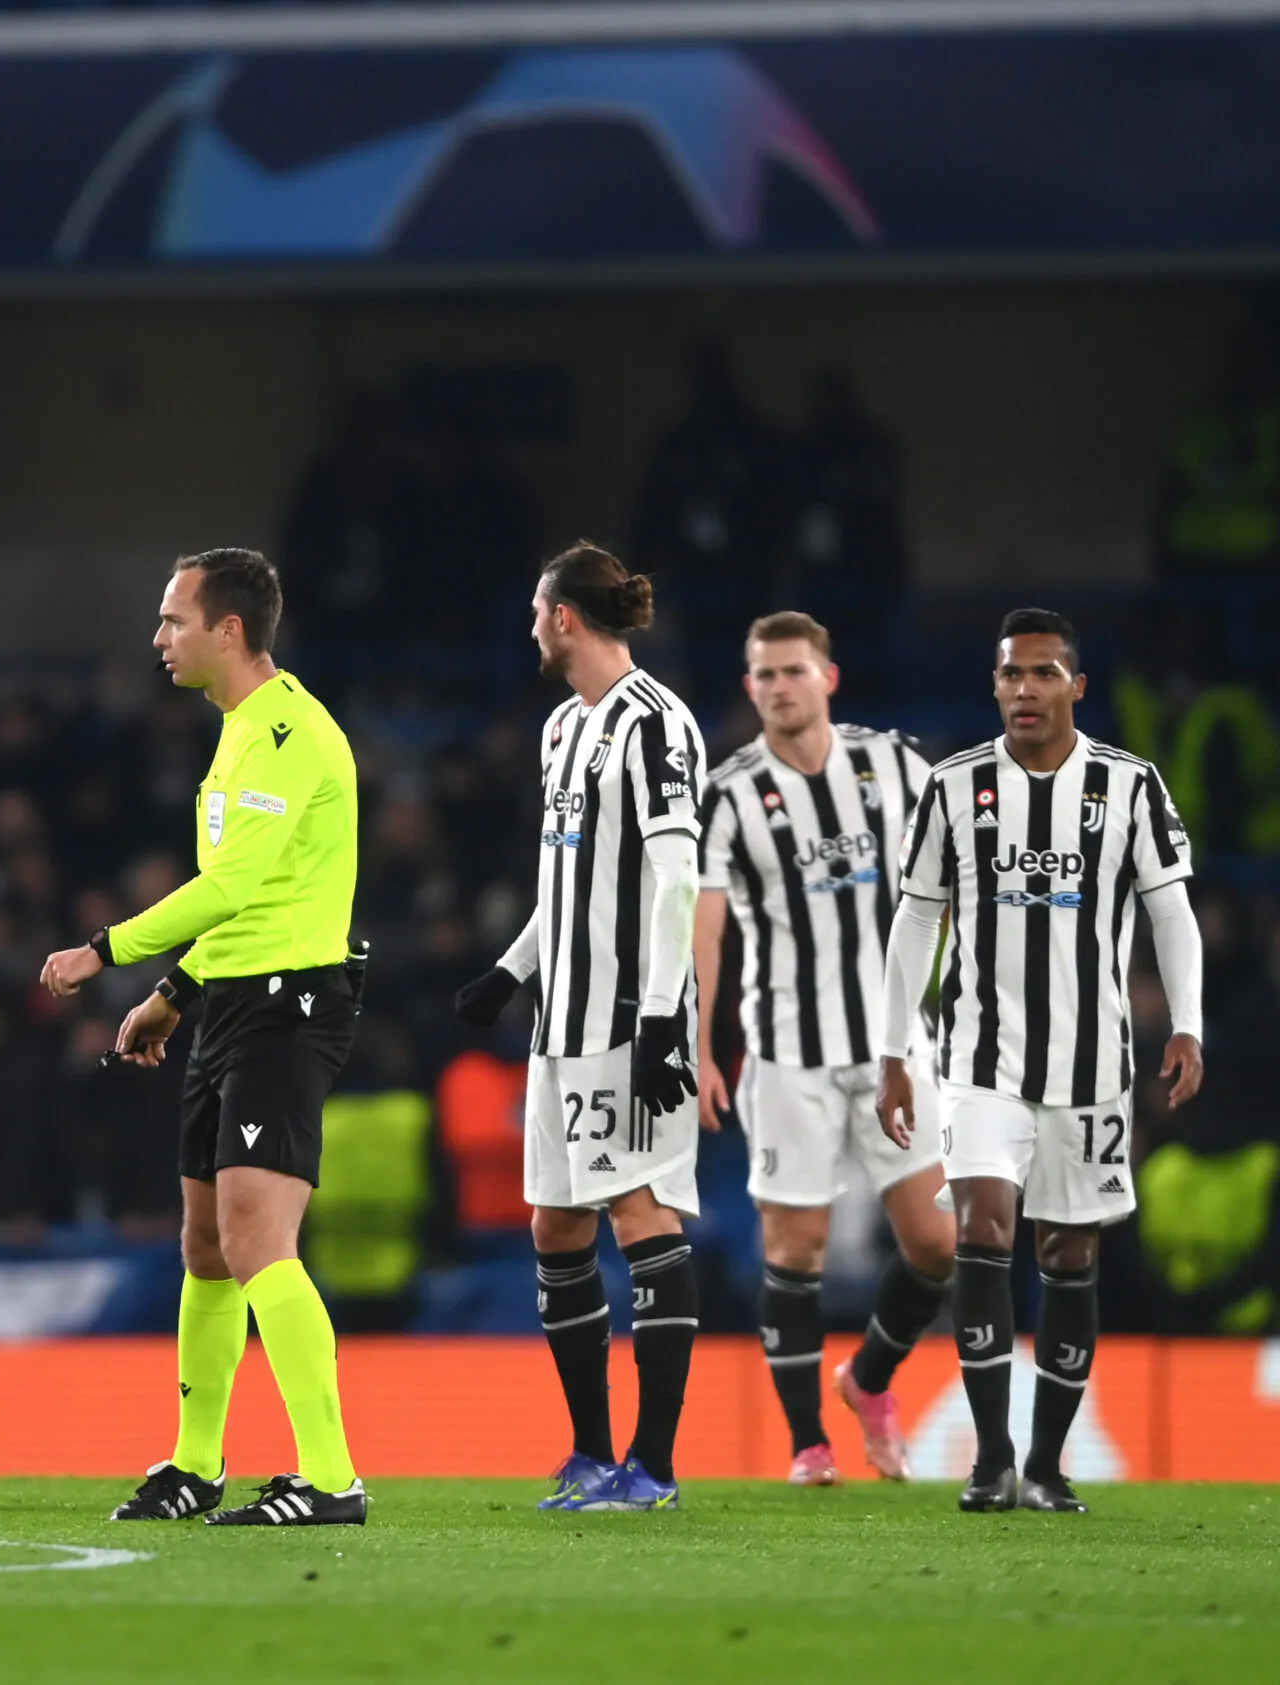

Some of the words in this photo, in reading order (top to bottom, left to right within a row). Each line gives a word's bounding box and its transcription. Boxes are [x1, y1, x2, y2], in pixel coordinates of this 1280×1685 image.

[795, 831, 877, 867] Jeep
[992, 843, 1084, 880] Jeep
[565, 1090, 616, 1142] 25
[1078, 1114, 1125, 1164] 12
